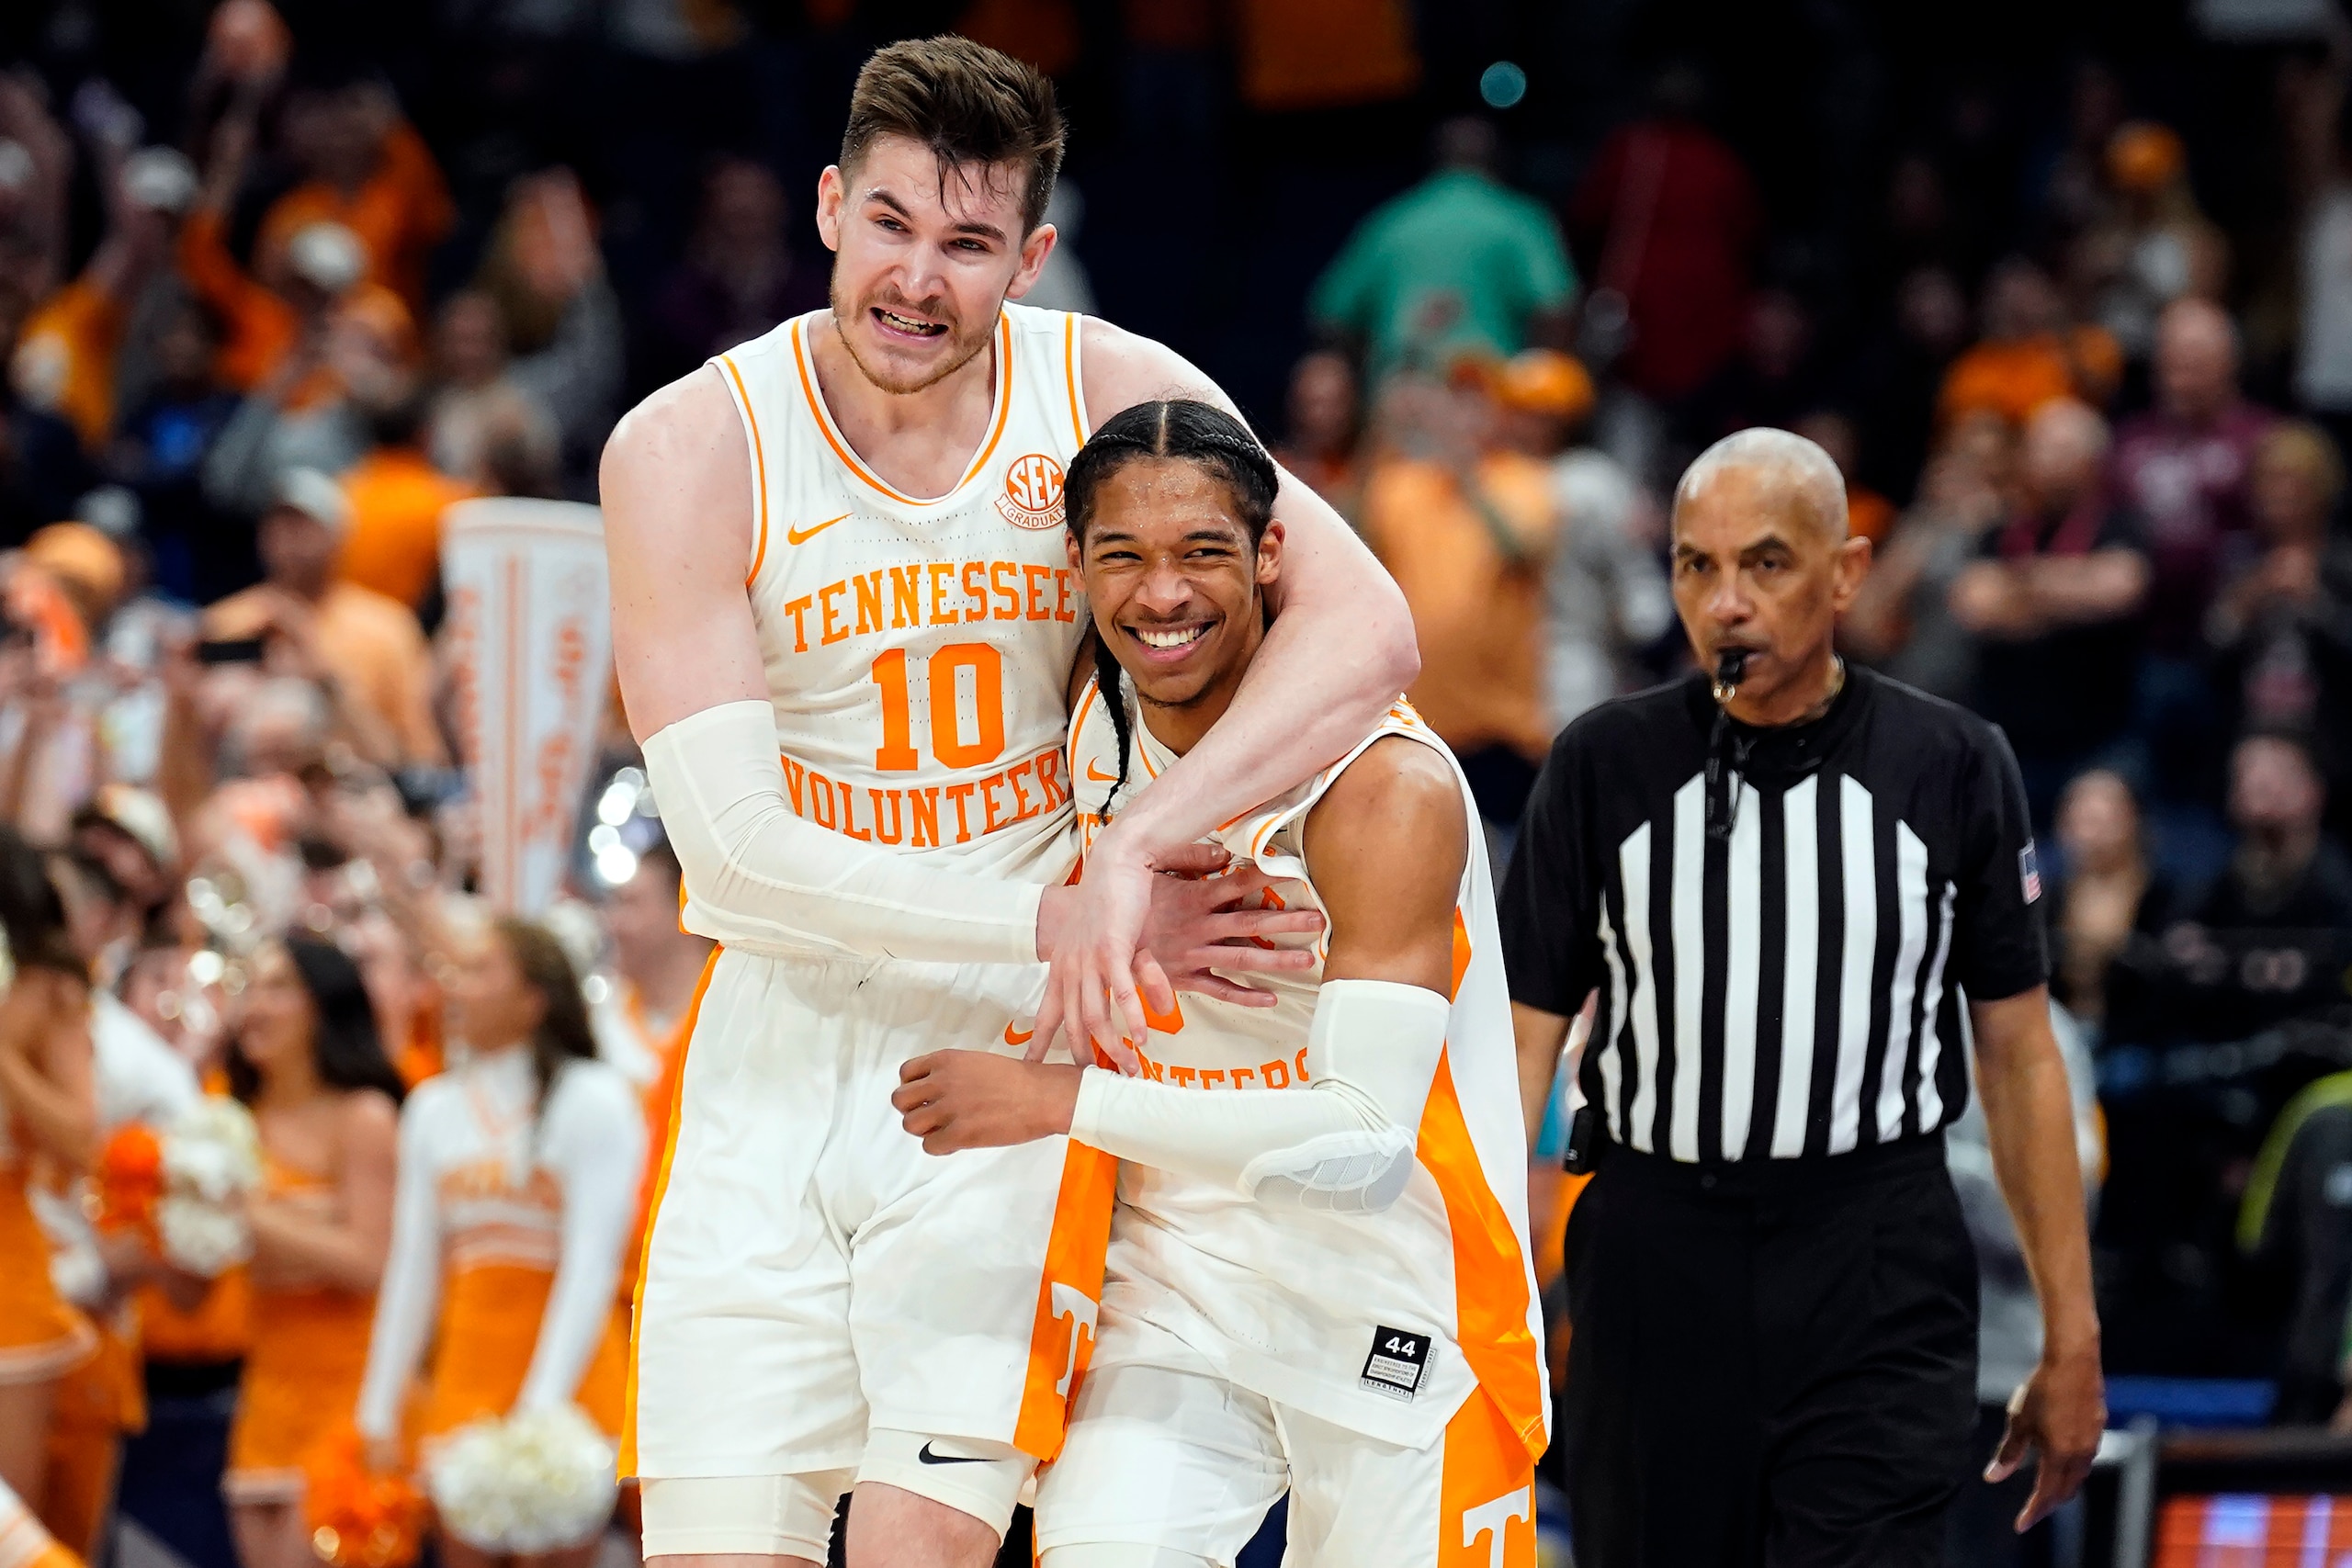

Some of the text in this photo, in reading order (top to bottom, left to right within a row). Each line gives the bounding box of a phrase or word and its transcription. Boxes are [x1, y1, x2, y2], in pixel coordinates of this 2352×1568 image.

[1009, 457, 1061, 509] SEC
[785, 561, 1075, 652] TENNESSEE
[872, 642, 1005, 771] 10
[1385, 1337, 1416, 1357] 44
